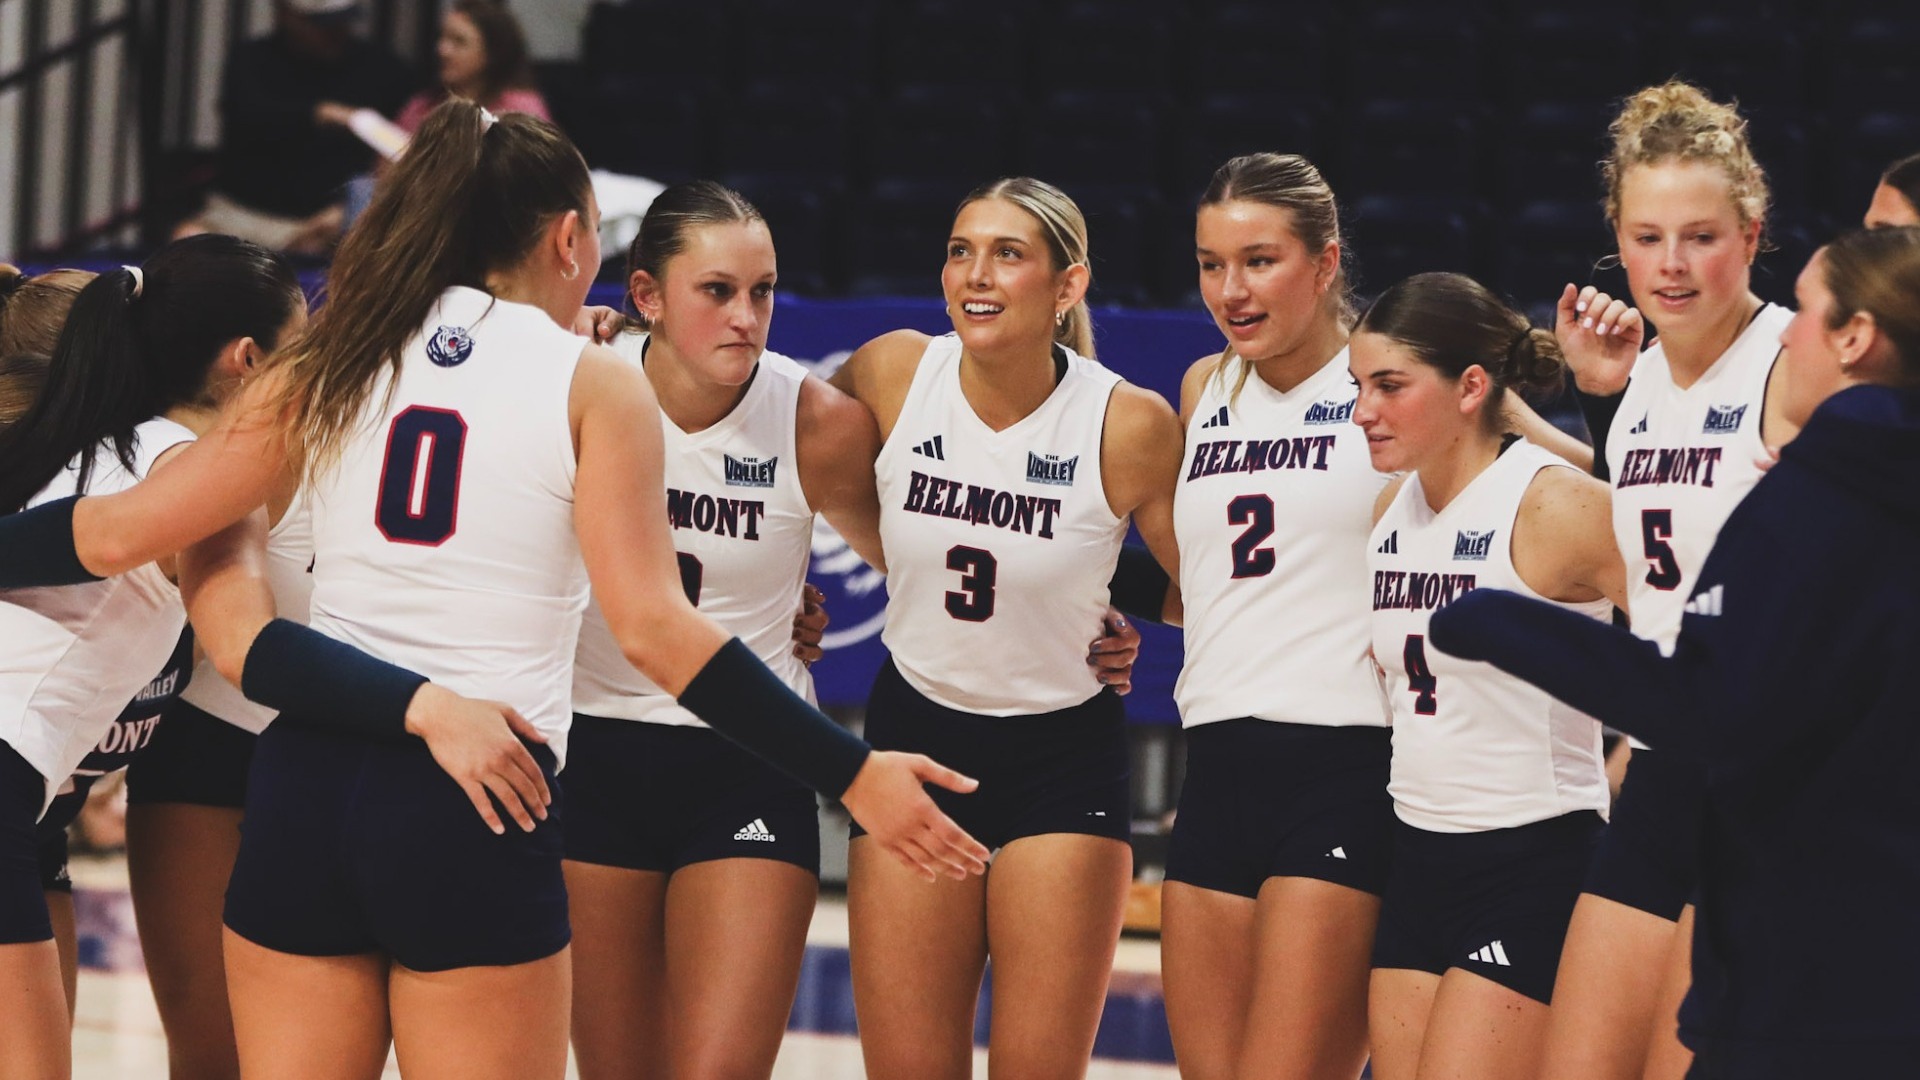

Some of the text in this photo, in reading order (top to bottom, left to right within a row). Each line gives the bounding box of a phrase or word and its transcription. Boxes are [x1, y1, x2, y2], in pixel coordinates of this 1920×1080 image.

[1305, 398, 1357, 421] VALLEY
[375, 404, 468, 547] 0
[723, 454, 778, 484] VALLEY
[1026, 450, 1080, 482] VALLEY
[1187, 435, 1336, 483] BELMONT
[1617, 447, 1723, 489] BELMONT
[903, 470, 1062, 540] BELMONT
[1226, 493, 1276, 579] 2
[1641, 509, 1682, 591] 5
[944, 544, 998, 623] 3
[1373, 570, 1477, 613] BELMONT
[1403, 634, 1437, 716] 4
[94, 713, 162, 754] ONT
[733, 830, 776, 842] adidas
